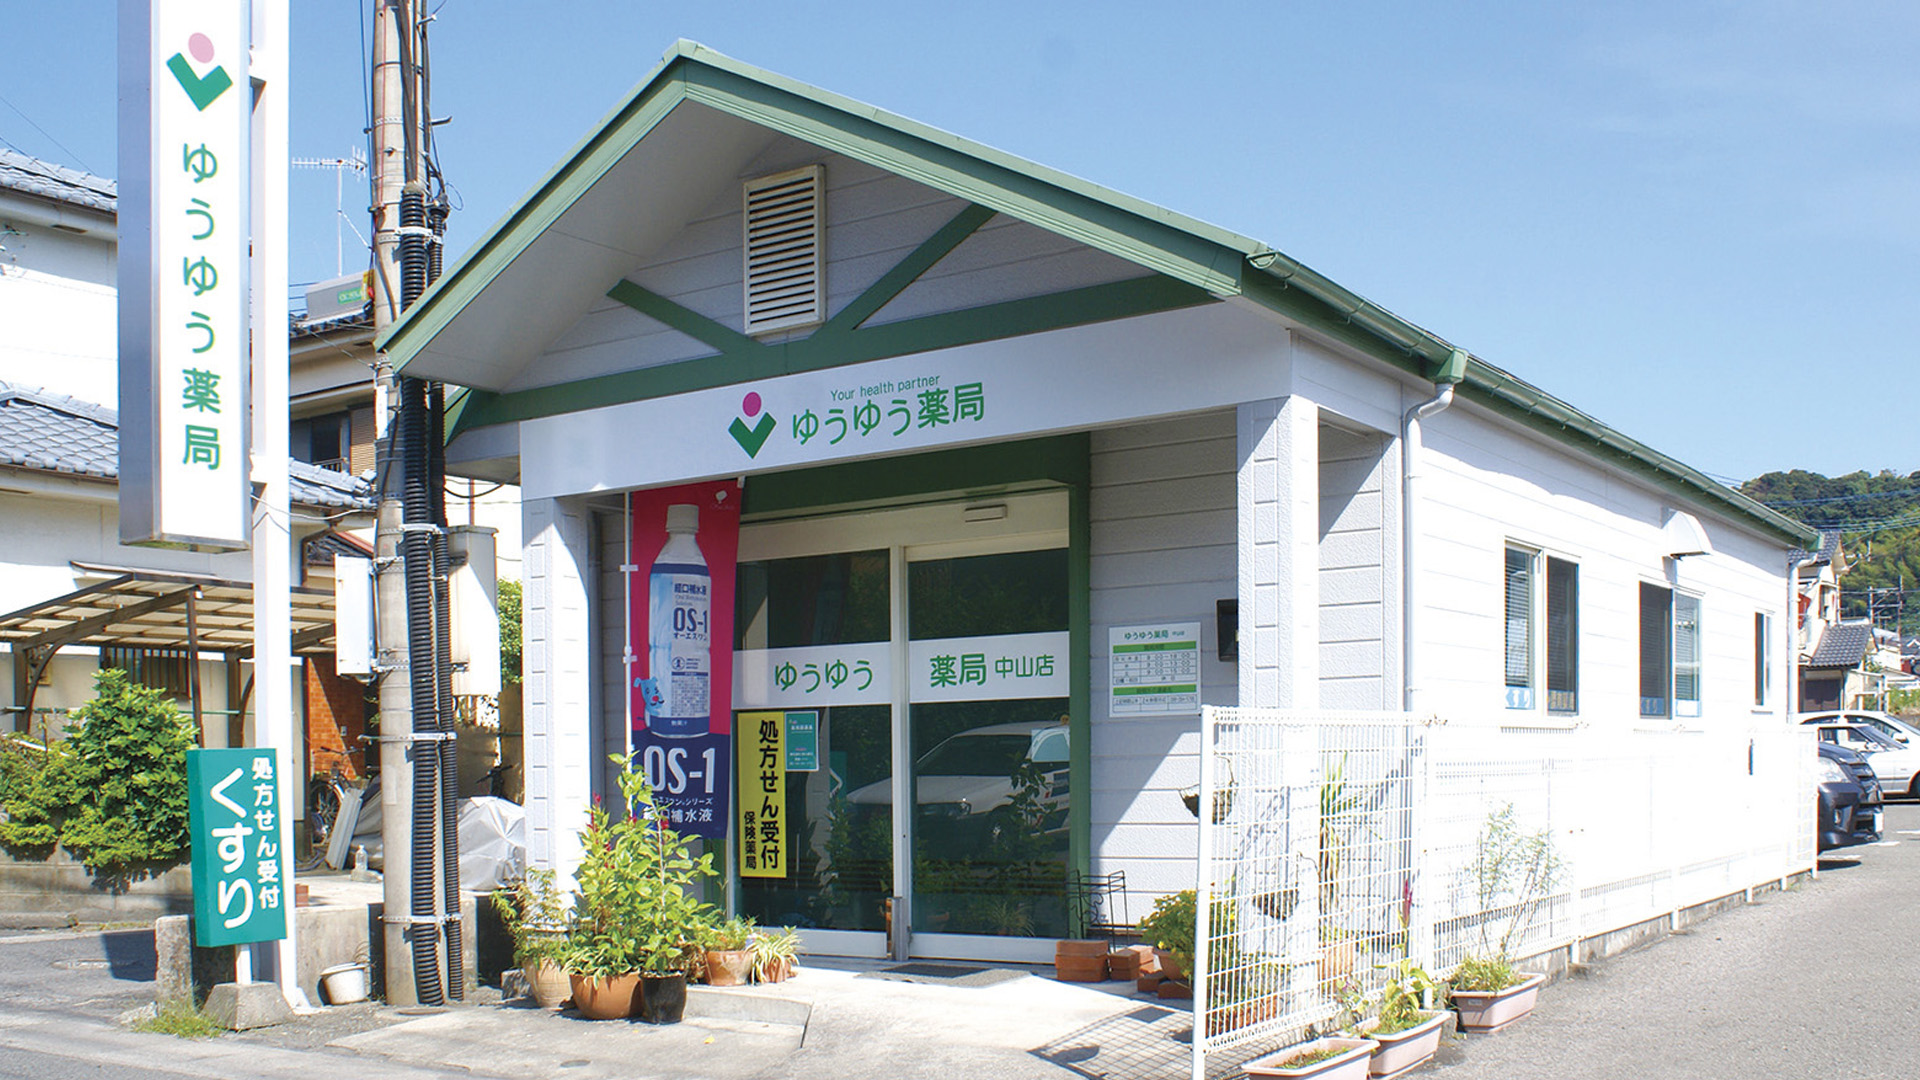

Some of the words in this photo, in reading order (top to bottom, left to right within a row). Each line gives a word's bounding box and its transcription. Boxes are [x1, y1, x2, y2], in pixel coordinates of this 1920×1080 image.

[182, 142, 221, 470] ゆうゆう薬局
[792, 382, 984, 446] ゆうゆう薬局
[830, 390, 855, 402] Your
[860, 382, 894, 397] health
[897, 375, 941, 392] partner
[673, 607, 708, 634] OS-1
[775, 659, 873, 693] ゆうゆう
[930, 653, 987, 688] 薬局
[994, 654, 1055, 679] 中山店
[644, 745, 716, 795] OS-1
[758, 719, 780, 870] 処方せん受付
[210, 767, 254, 930] くすり
[252, 757, 281, 910] 処方せん受付
[744, 811, 757, 870] 保険薬局
